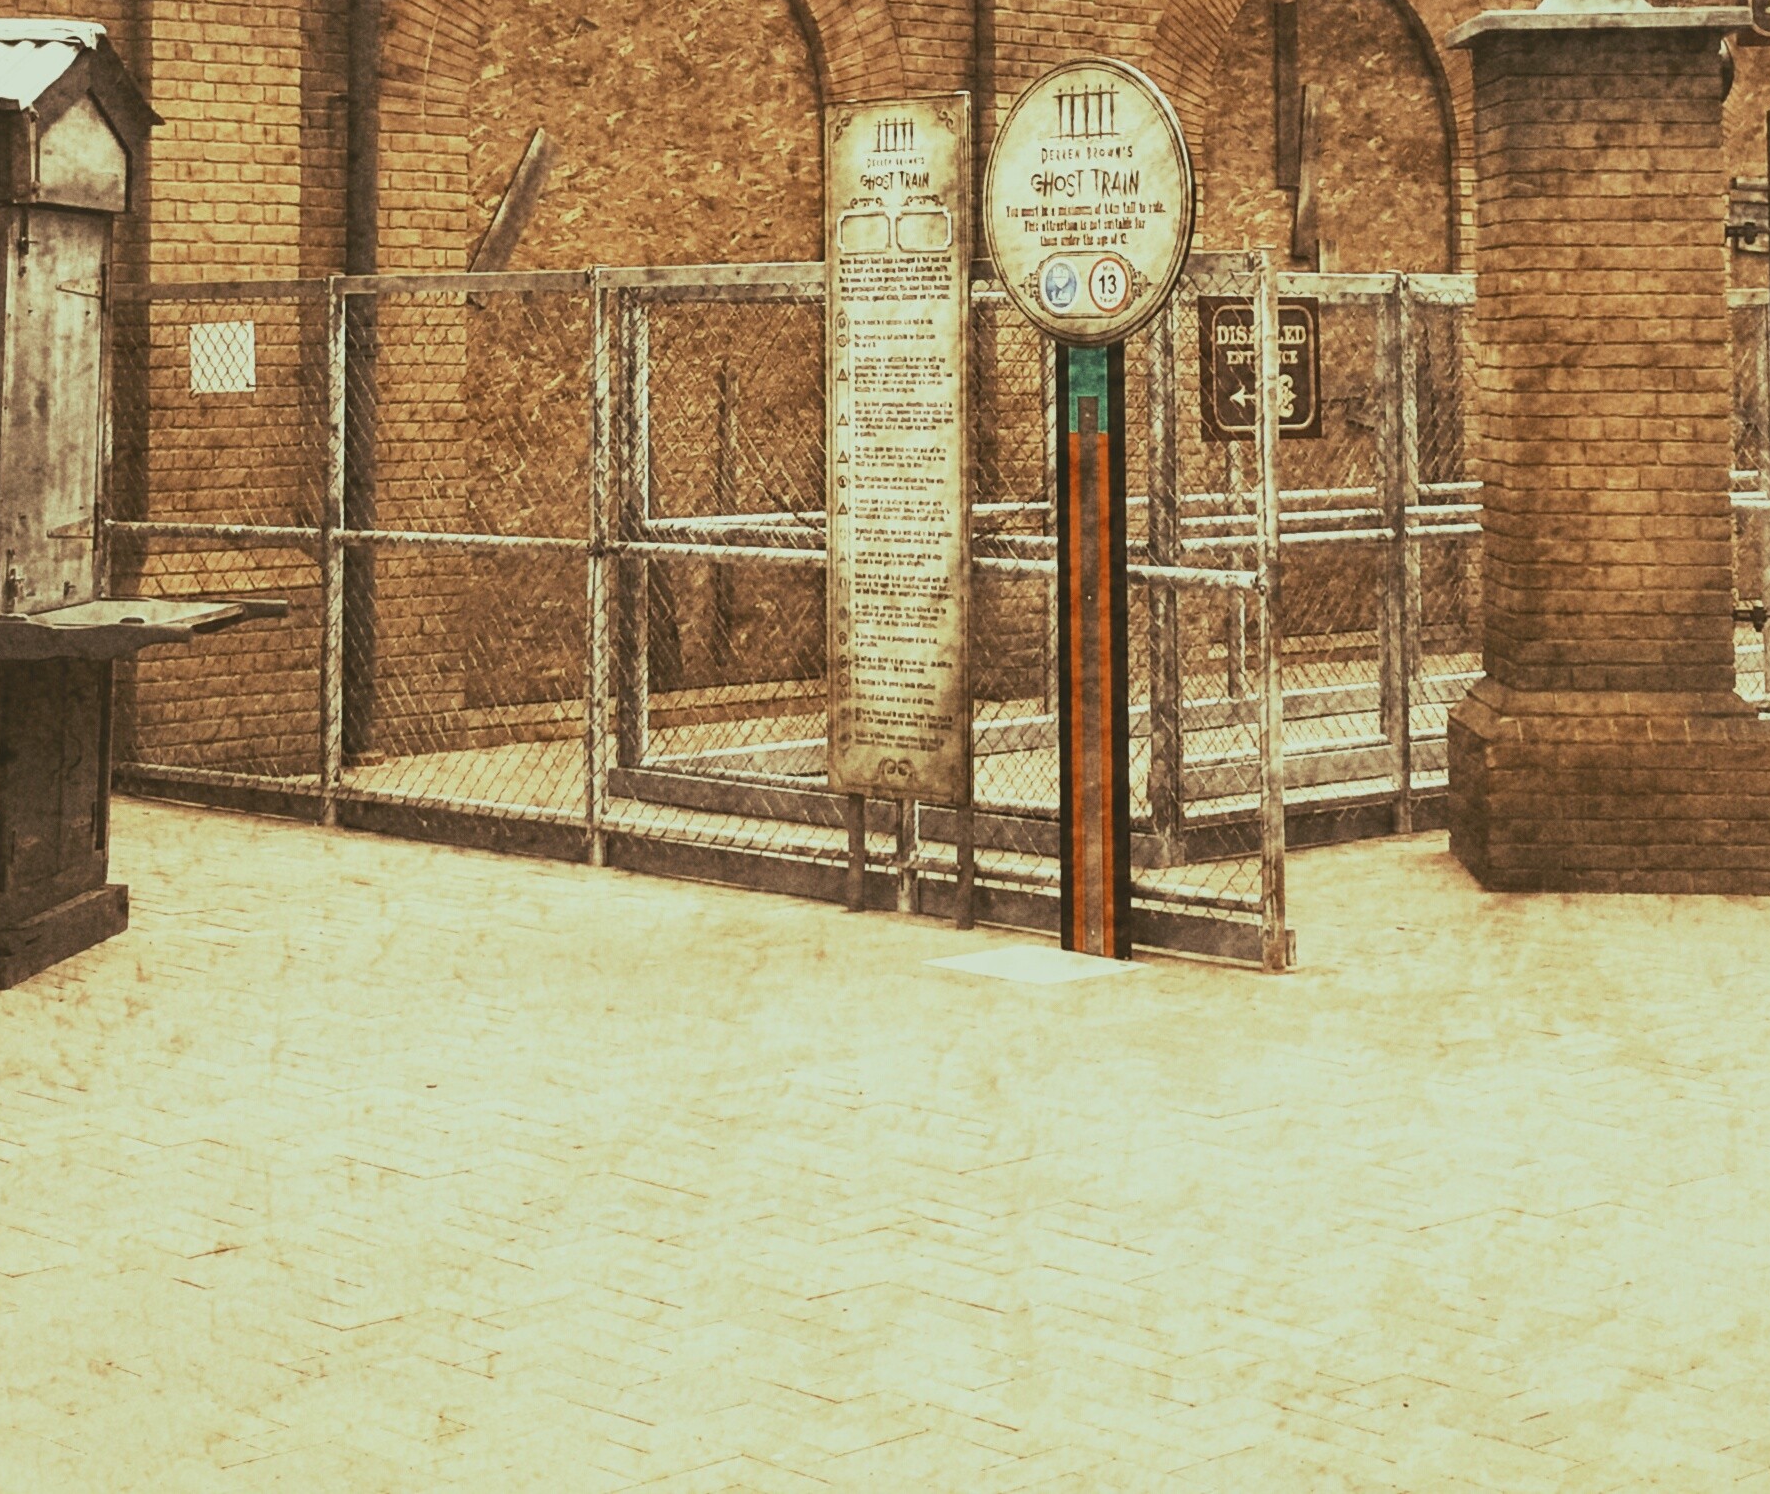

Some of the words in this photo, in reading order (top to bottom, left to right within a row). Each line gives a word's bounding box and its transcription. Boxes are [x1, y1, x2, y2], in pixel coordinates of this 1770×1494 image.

[860, 171, 894, 190] GHOST
[898, 171, 929, 190] TRAIN
[1031, 169, 1084, 197] GHOST
[1090, 168, 1140, 198] TRAIN
[1099, 274, 1117, 294] 13
